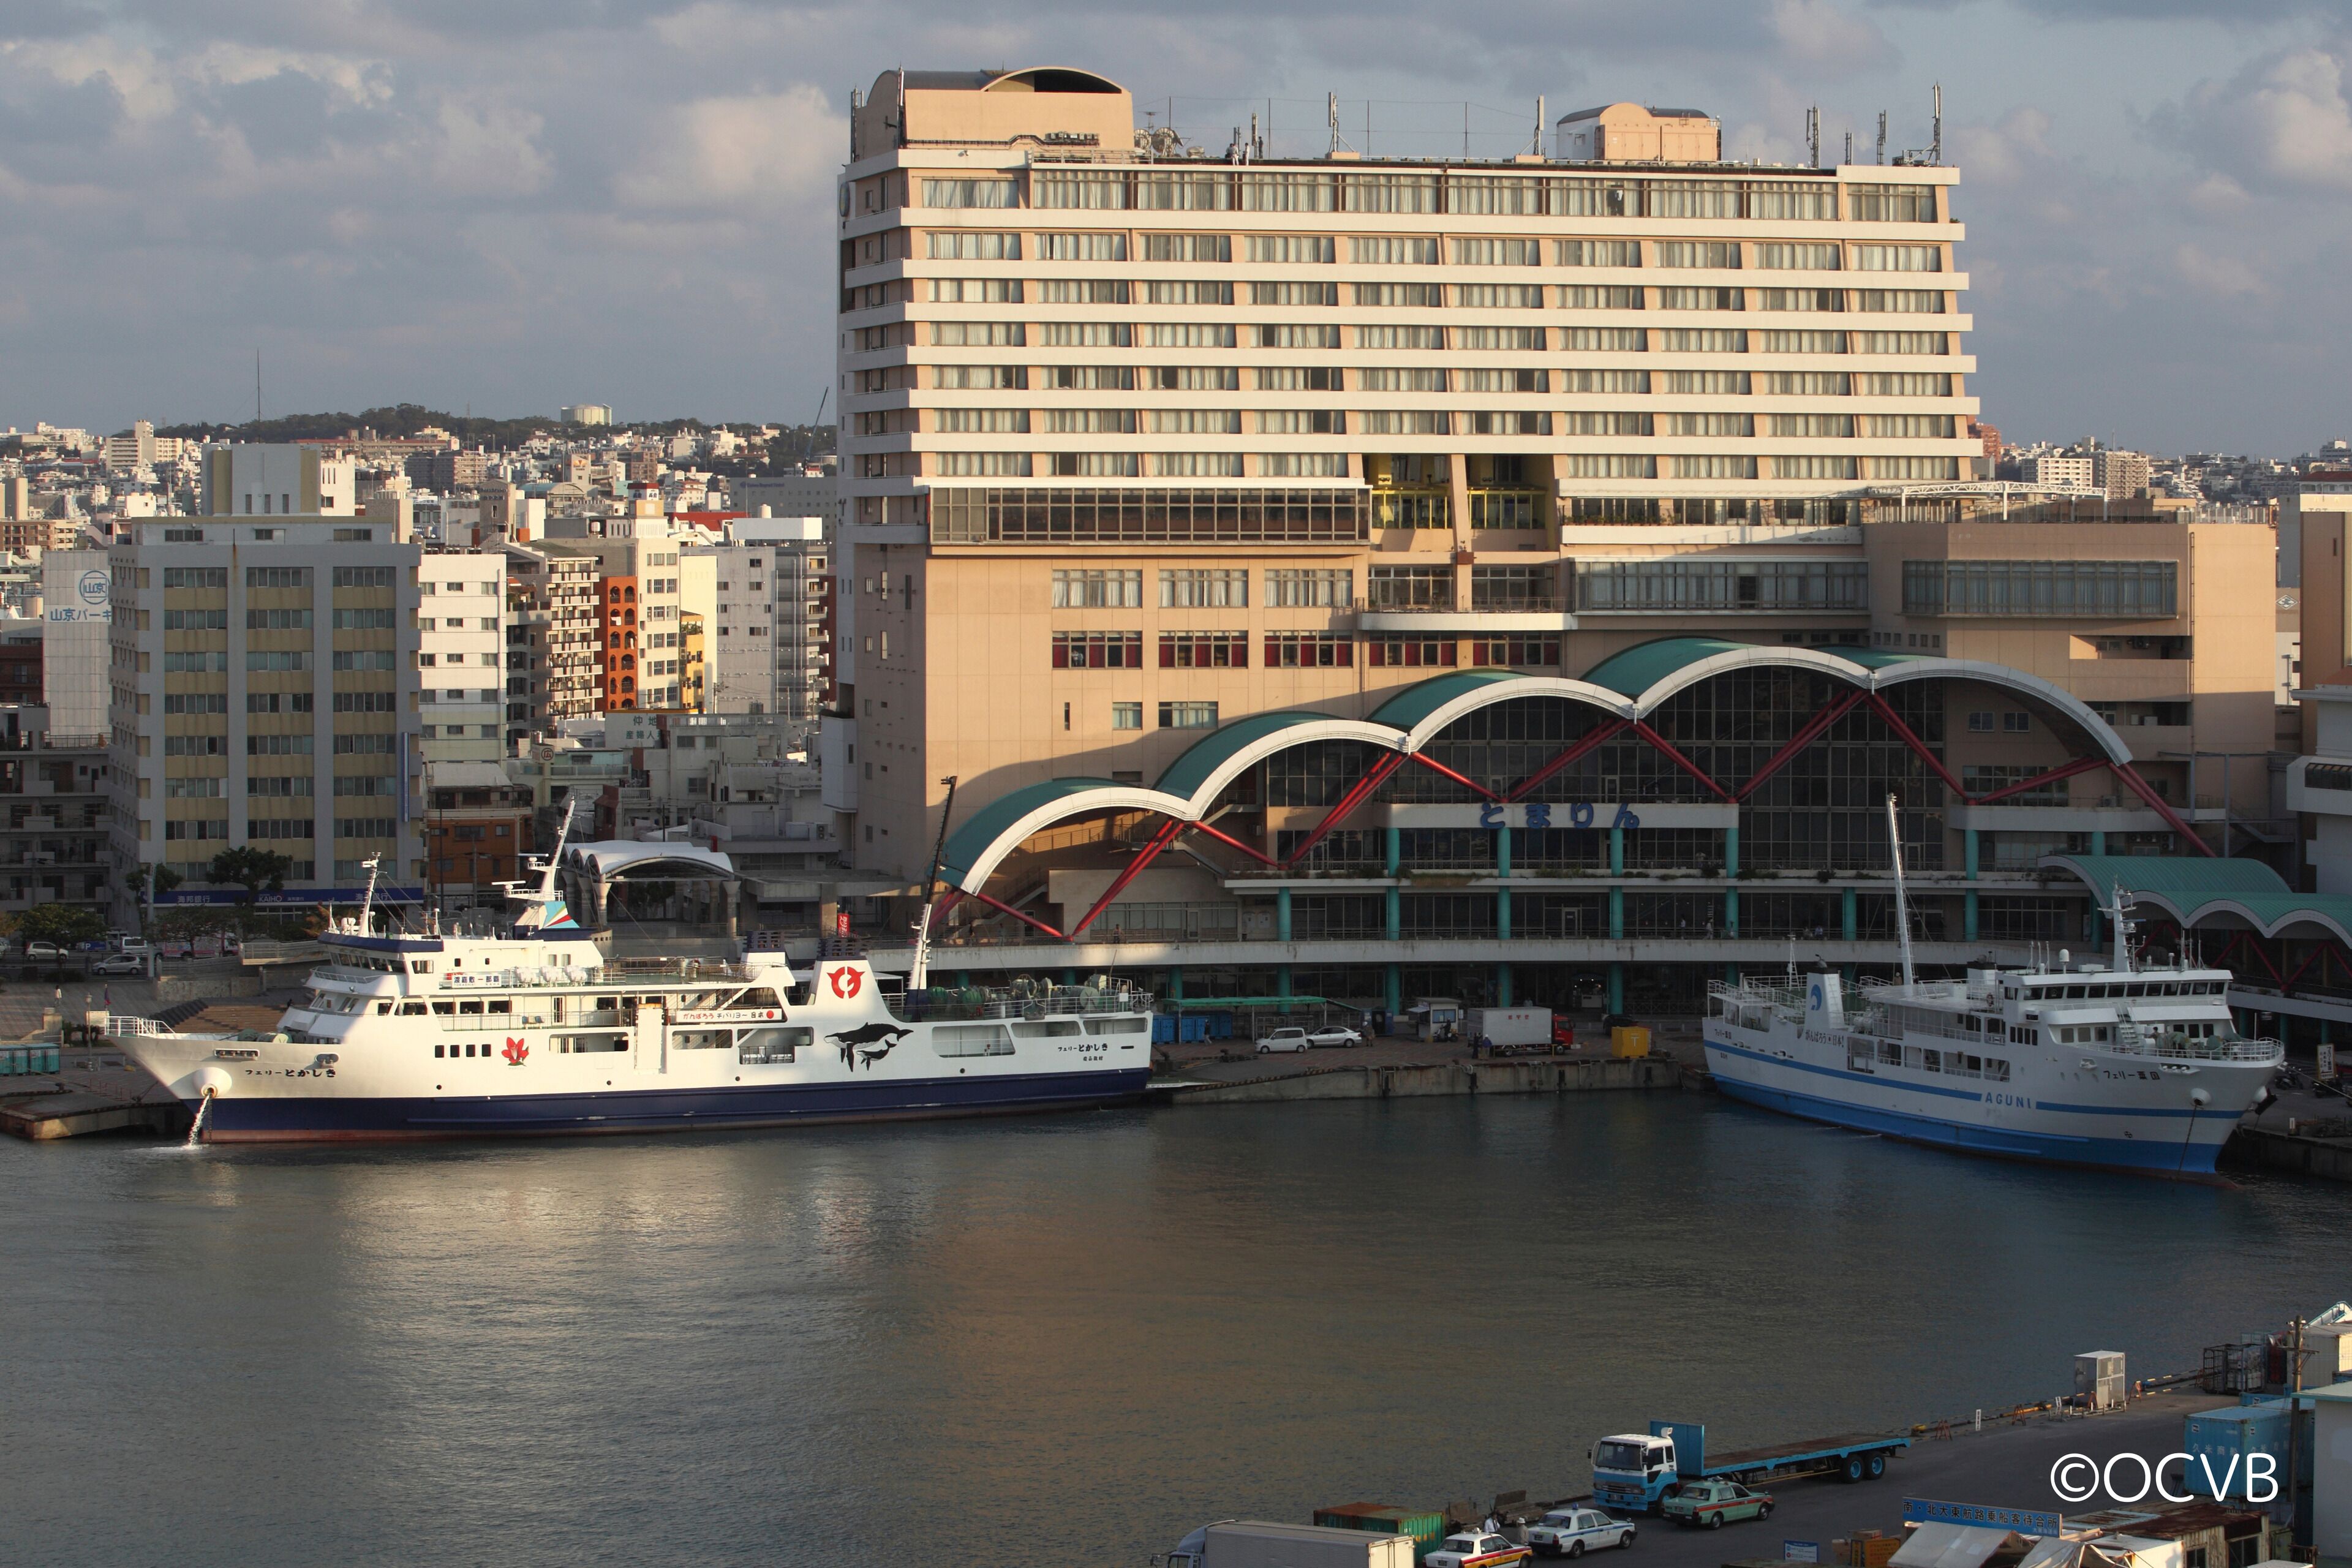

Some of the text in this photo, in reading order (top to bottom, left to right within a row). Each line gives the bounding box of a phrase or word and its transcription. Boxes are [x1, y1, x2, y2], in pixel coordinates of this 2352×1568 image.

[85, 582, 105, 594] 山京
[50, 608, 111, 621] 山京パーキ
[1480, 802, 1640, 829] とまりん
[1058, 1043, 1108, 1052] フェリーとかしき
[245, 1069, 336, 1077] フェリーとかしき
[1985, 1091, 2032, 1109] AGUNI
[1902, 1501, 2059, 1529] 南・北大東航路乗船客待合所
